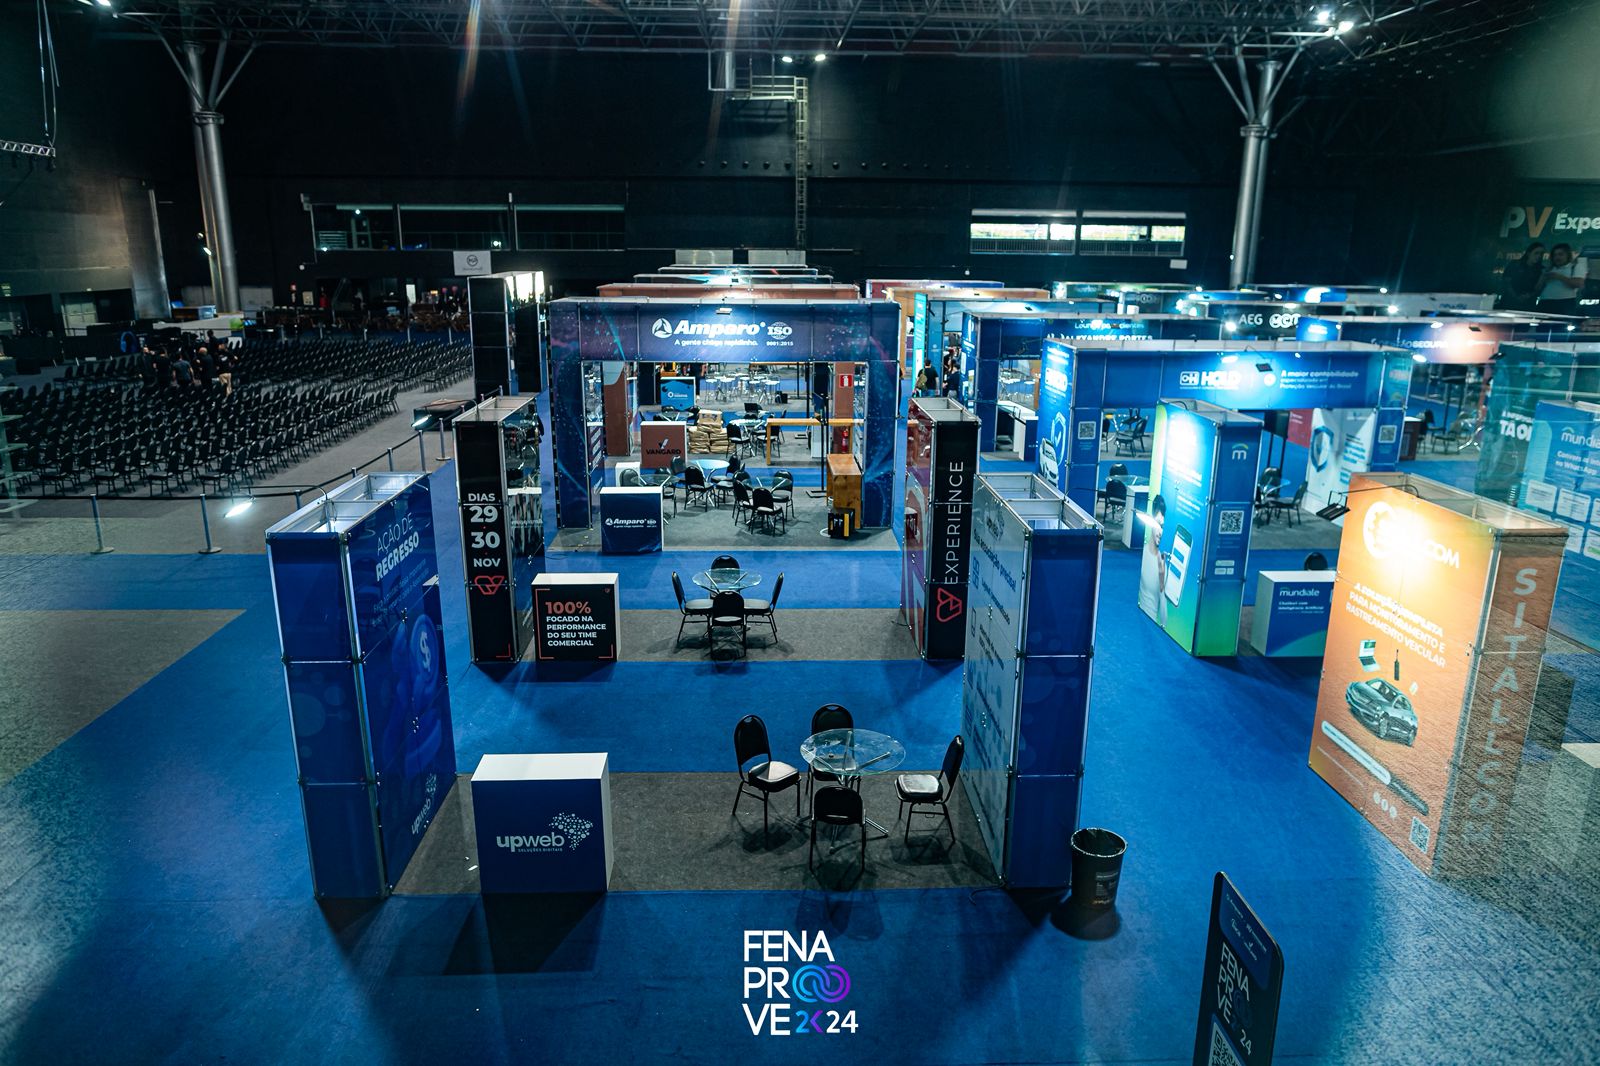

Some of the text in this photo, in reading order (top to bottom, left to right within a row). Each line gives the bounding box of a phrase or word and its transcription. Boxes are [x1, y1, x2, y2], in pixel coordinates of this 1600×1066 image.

[1499, 206, 1553, 238] PV
[1239, 314, 1263, 325] AEG
[674, 320, 760, 338] Amparo
[468, 493, 496, 502] DIAS
[469, 505, 499, 523] 29
[944, 461, 964, 585] EXPERIENCE
[376, 512, 415, 556] AÇÃO DE
[470, 531, 501, 549] 30
[375, 531, 419, 582] REGRESSO
[473, 558, 501, 568] NOV
[1280, 588, 1320, 597] mundiale
[545, 601, 592, 615] 100%
[546, 615, 580, 623] FOCADO
[546, 623, 607, 631] PERFORMANCE
[1345, 601, 1446, 668] RASTREAMENTO VEICULAR
[496, 832, 565, 852] upweb
[1221, 942, 1250, 1001] FENA
[1217, 984, 1233, 1024] VE
